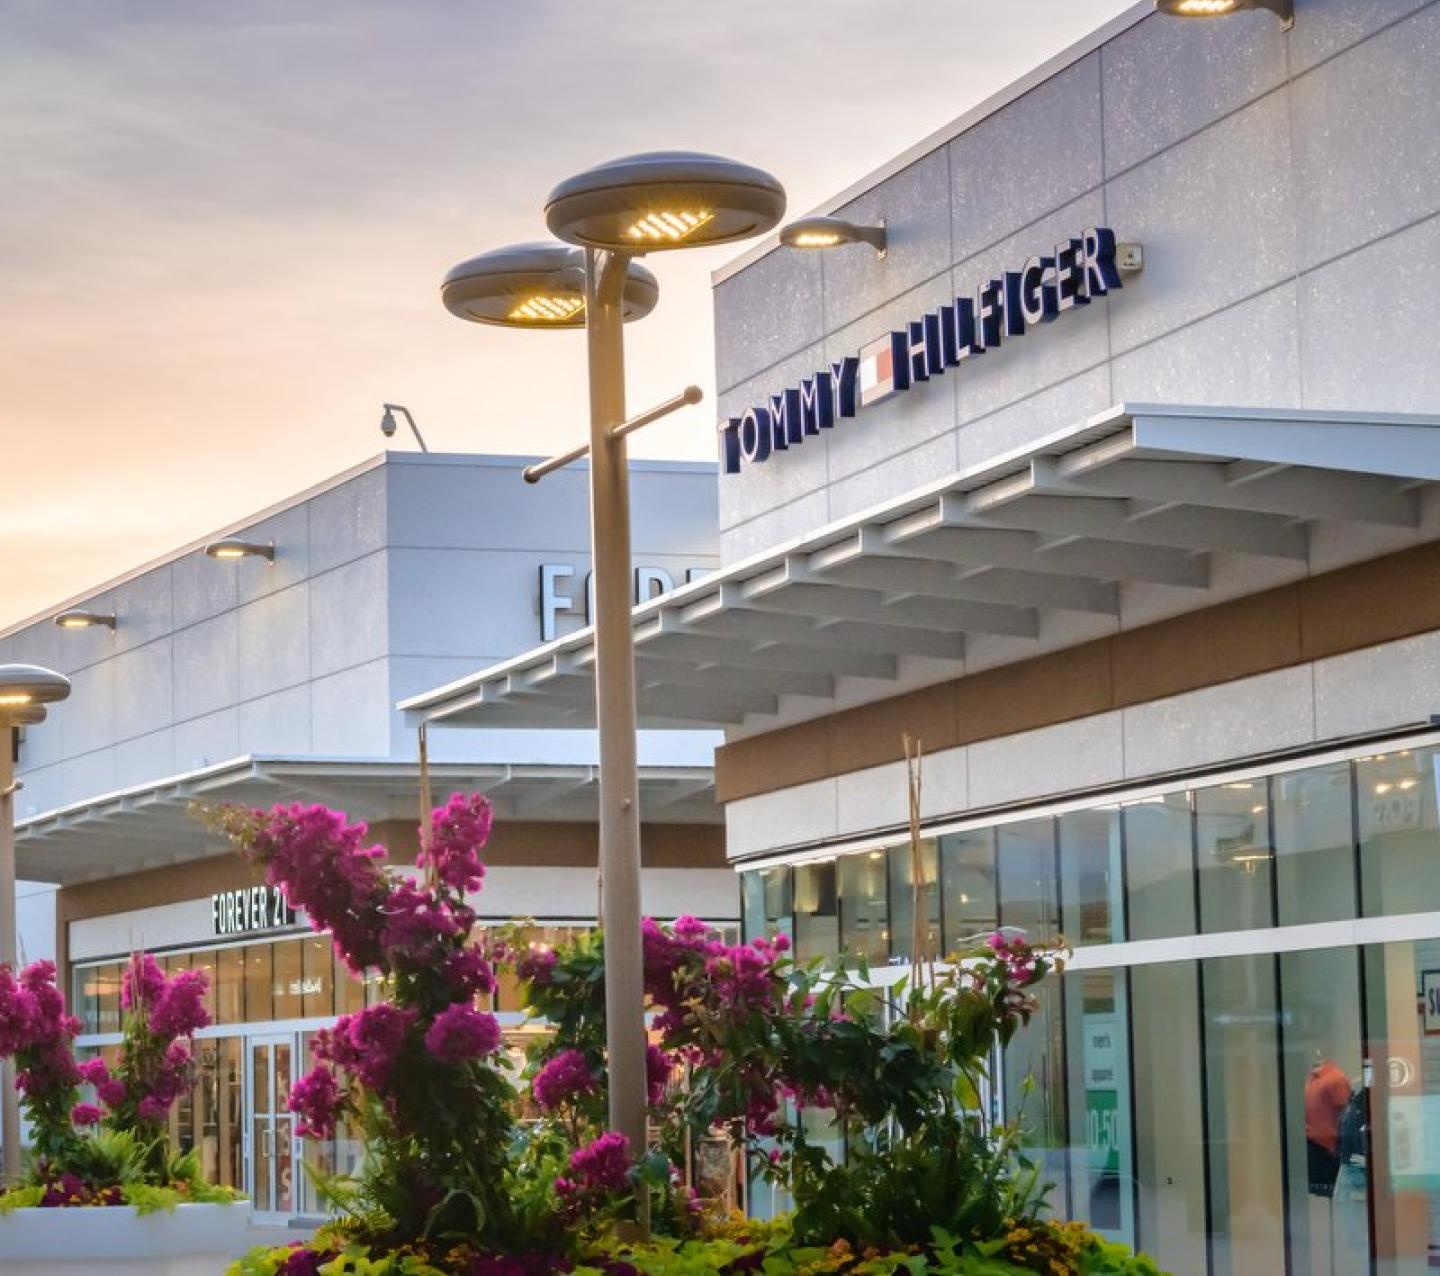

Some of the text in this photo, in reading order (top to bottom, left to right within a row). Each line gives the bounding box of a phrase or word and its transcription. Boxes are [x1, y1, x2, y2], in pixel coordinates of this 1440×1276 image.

[718, 226, 1122, 474] TOMMY HILFIGER
[211, 886, 291, 934] FOREVER 21
